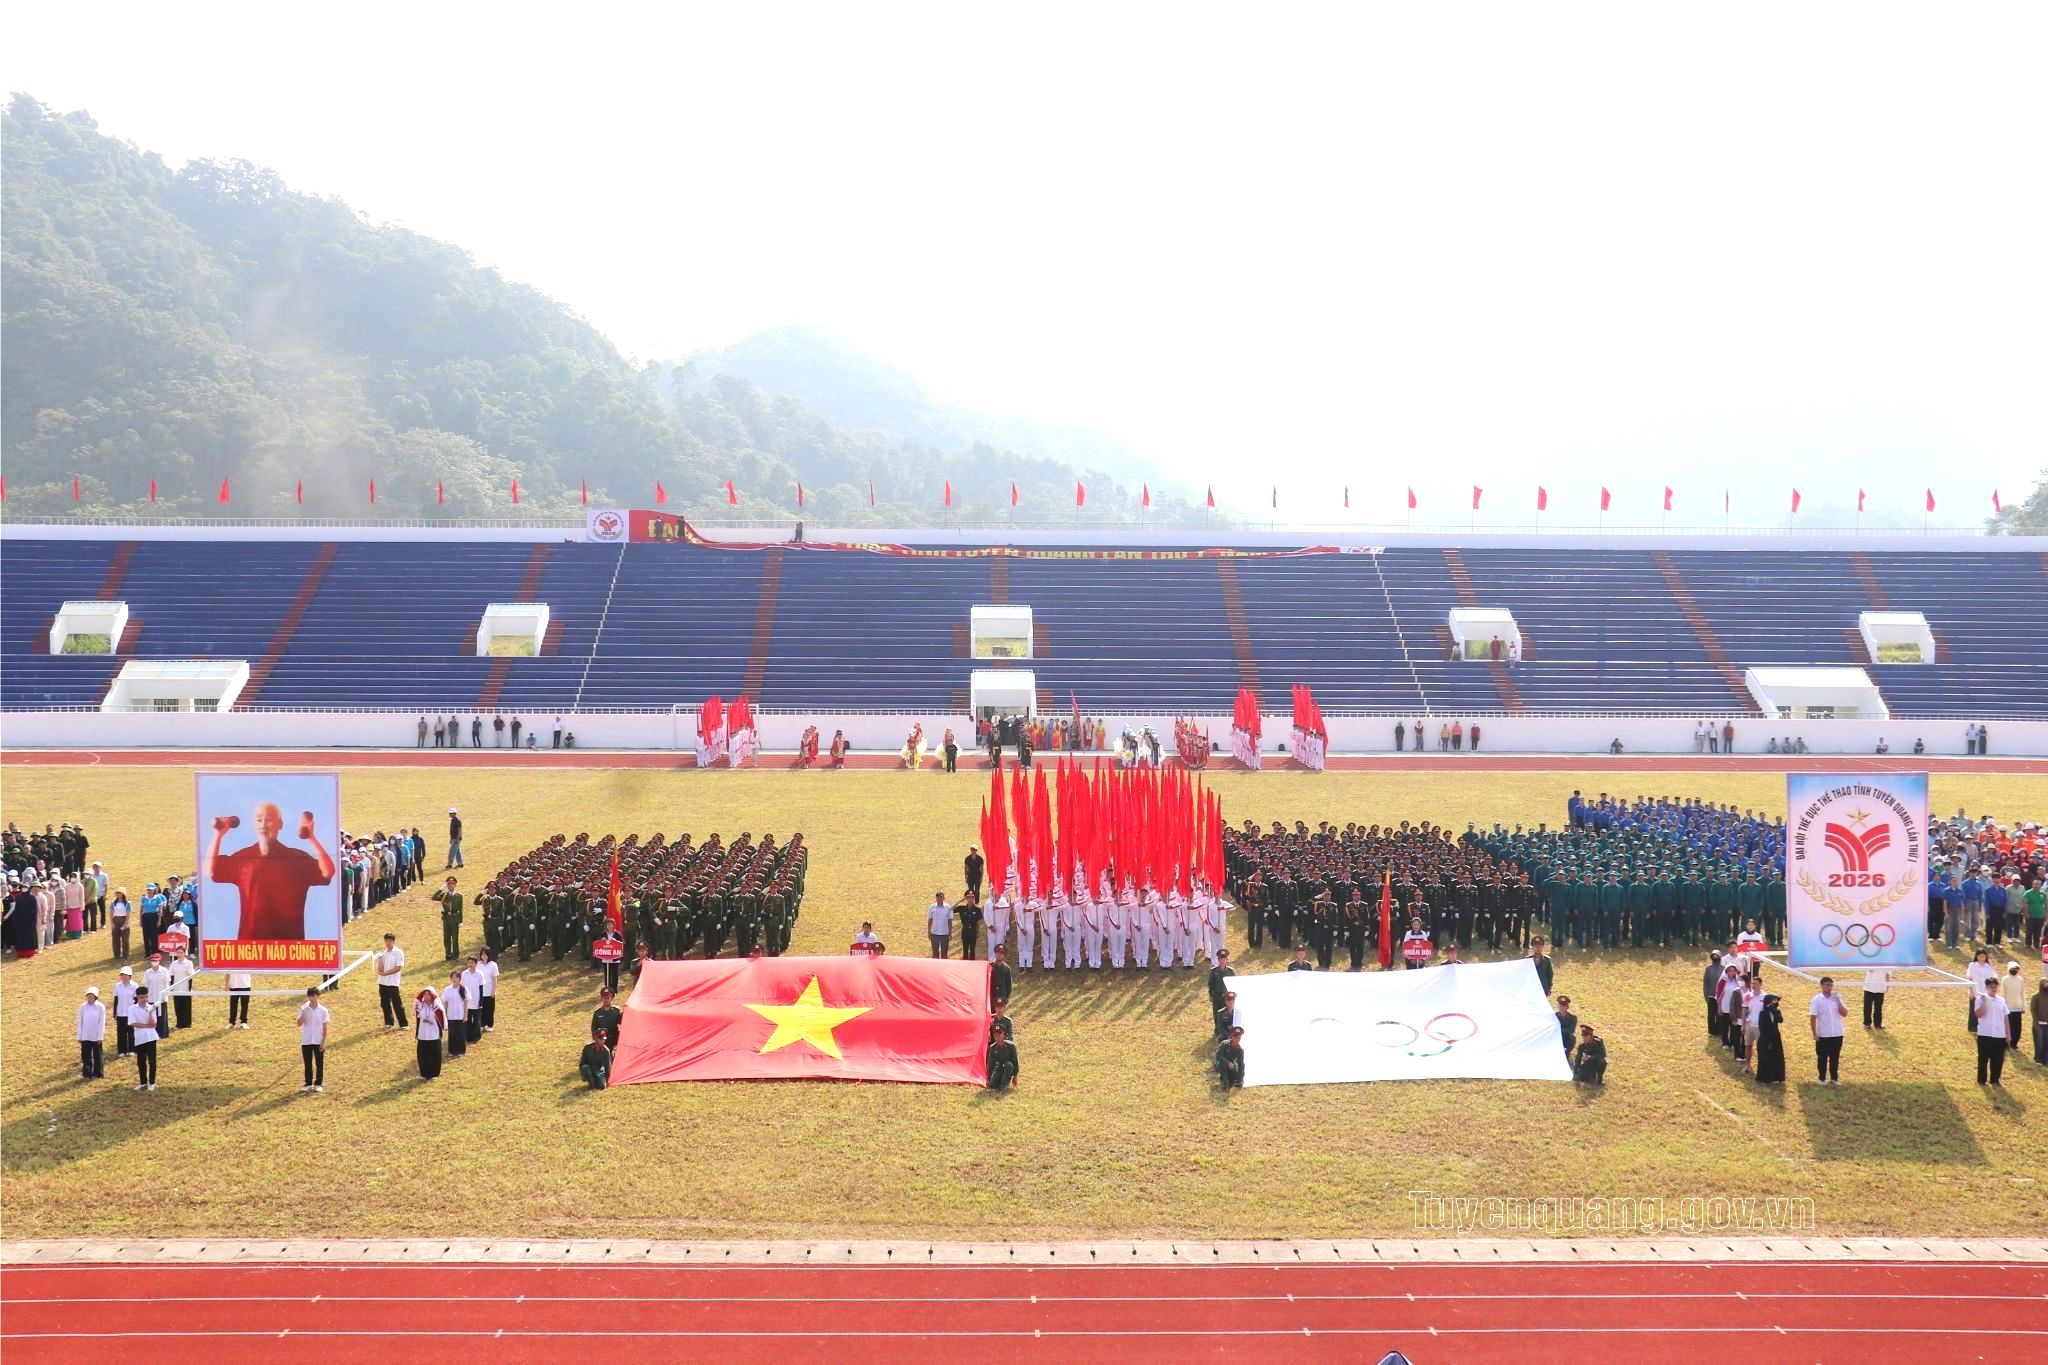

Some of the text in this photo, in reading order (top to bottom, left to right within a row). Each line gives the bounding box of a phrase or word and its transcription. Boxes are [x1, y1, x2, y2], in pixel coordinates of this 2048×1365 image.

[1794, 832, 1807, 846] HỘI
[1805, 803, 1821, 819] DỤC
[1832, 786, 1852, 799] THAO
[1853, 782, 1872, 796] TỈNH
[1873, 788, 1896, 807] TUYÊN
[1892, 802, 1913, 826] QUANG
[1828, 873, 1886, 887] 2026
[205, 941, 337, 964] TỰ TÔI NGÀY NÀO CŨNG TẬP
